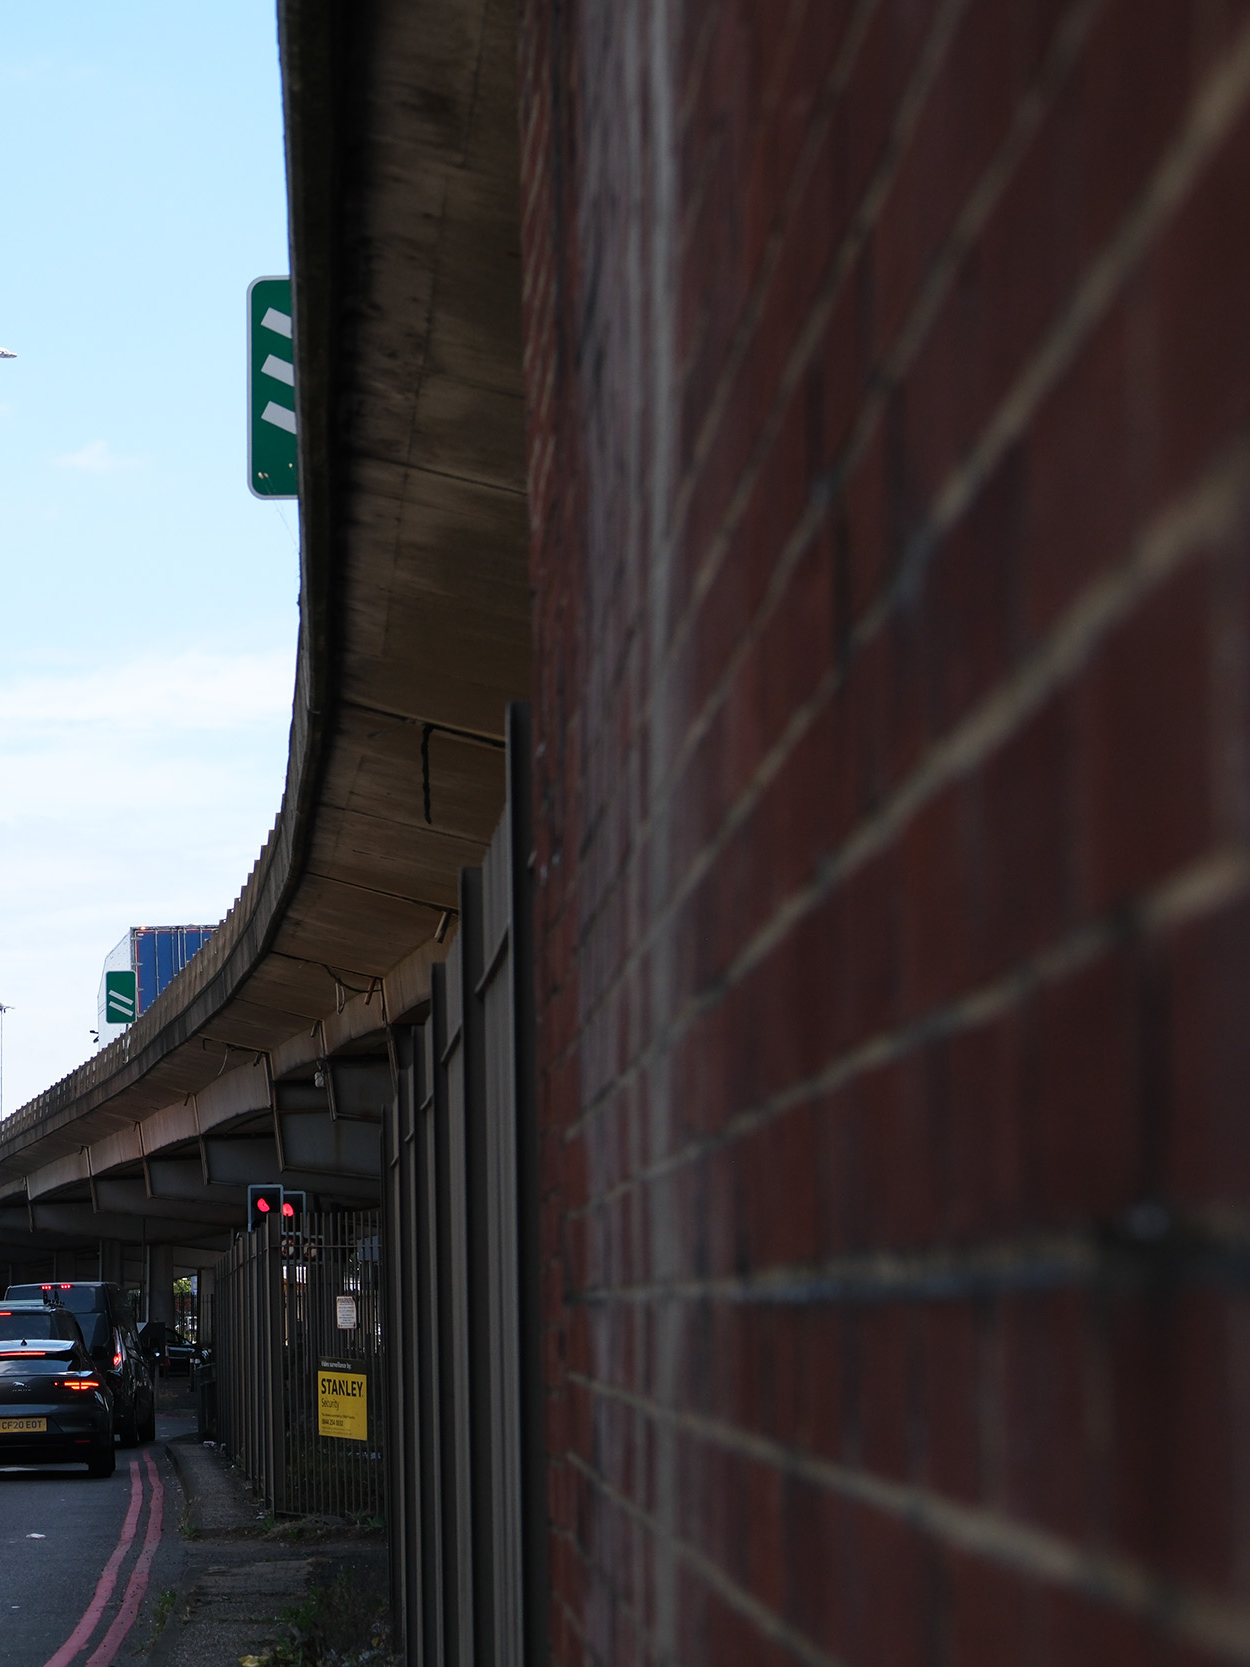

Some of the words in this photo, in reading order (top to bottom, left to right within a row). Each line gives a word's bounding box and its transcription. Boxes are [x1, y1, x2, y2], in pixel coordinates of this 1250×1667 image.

[321, 1378, 363, 1397] STANLEY
[322, 1398, 339, 1411] Security
[2, 1421, 24, 1429] CF20
[26, 1420, 42, 1429] EOT
